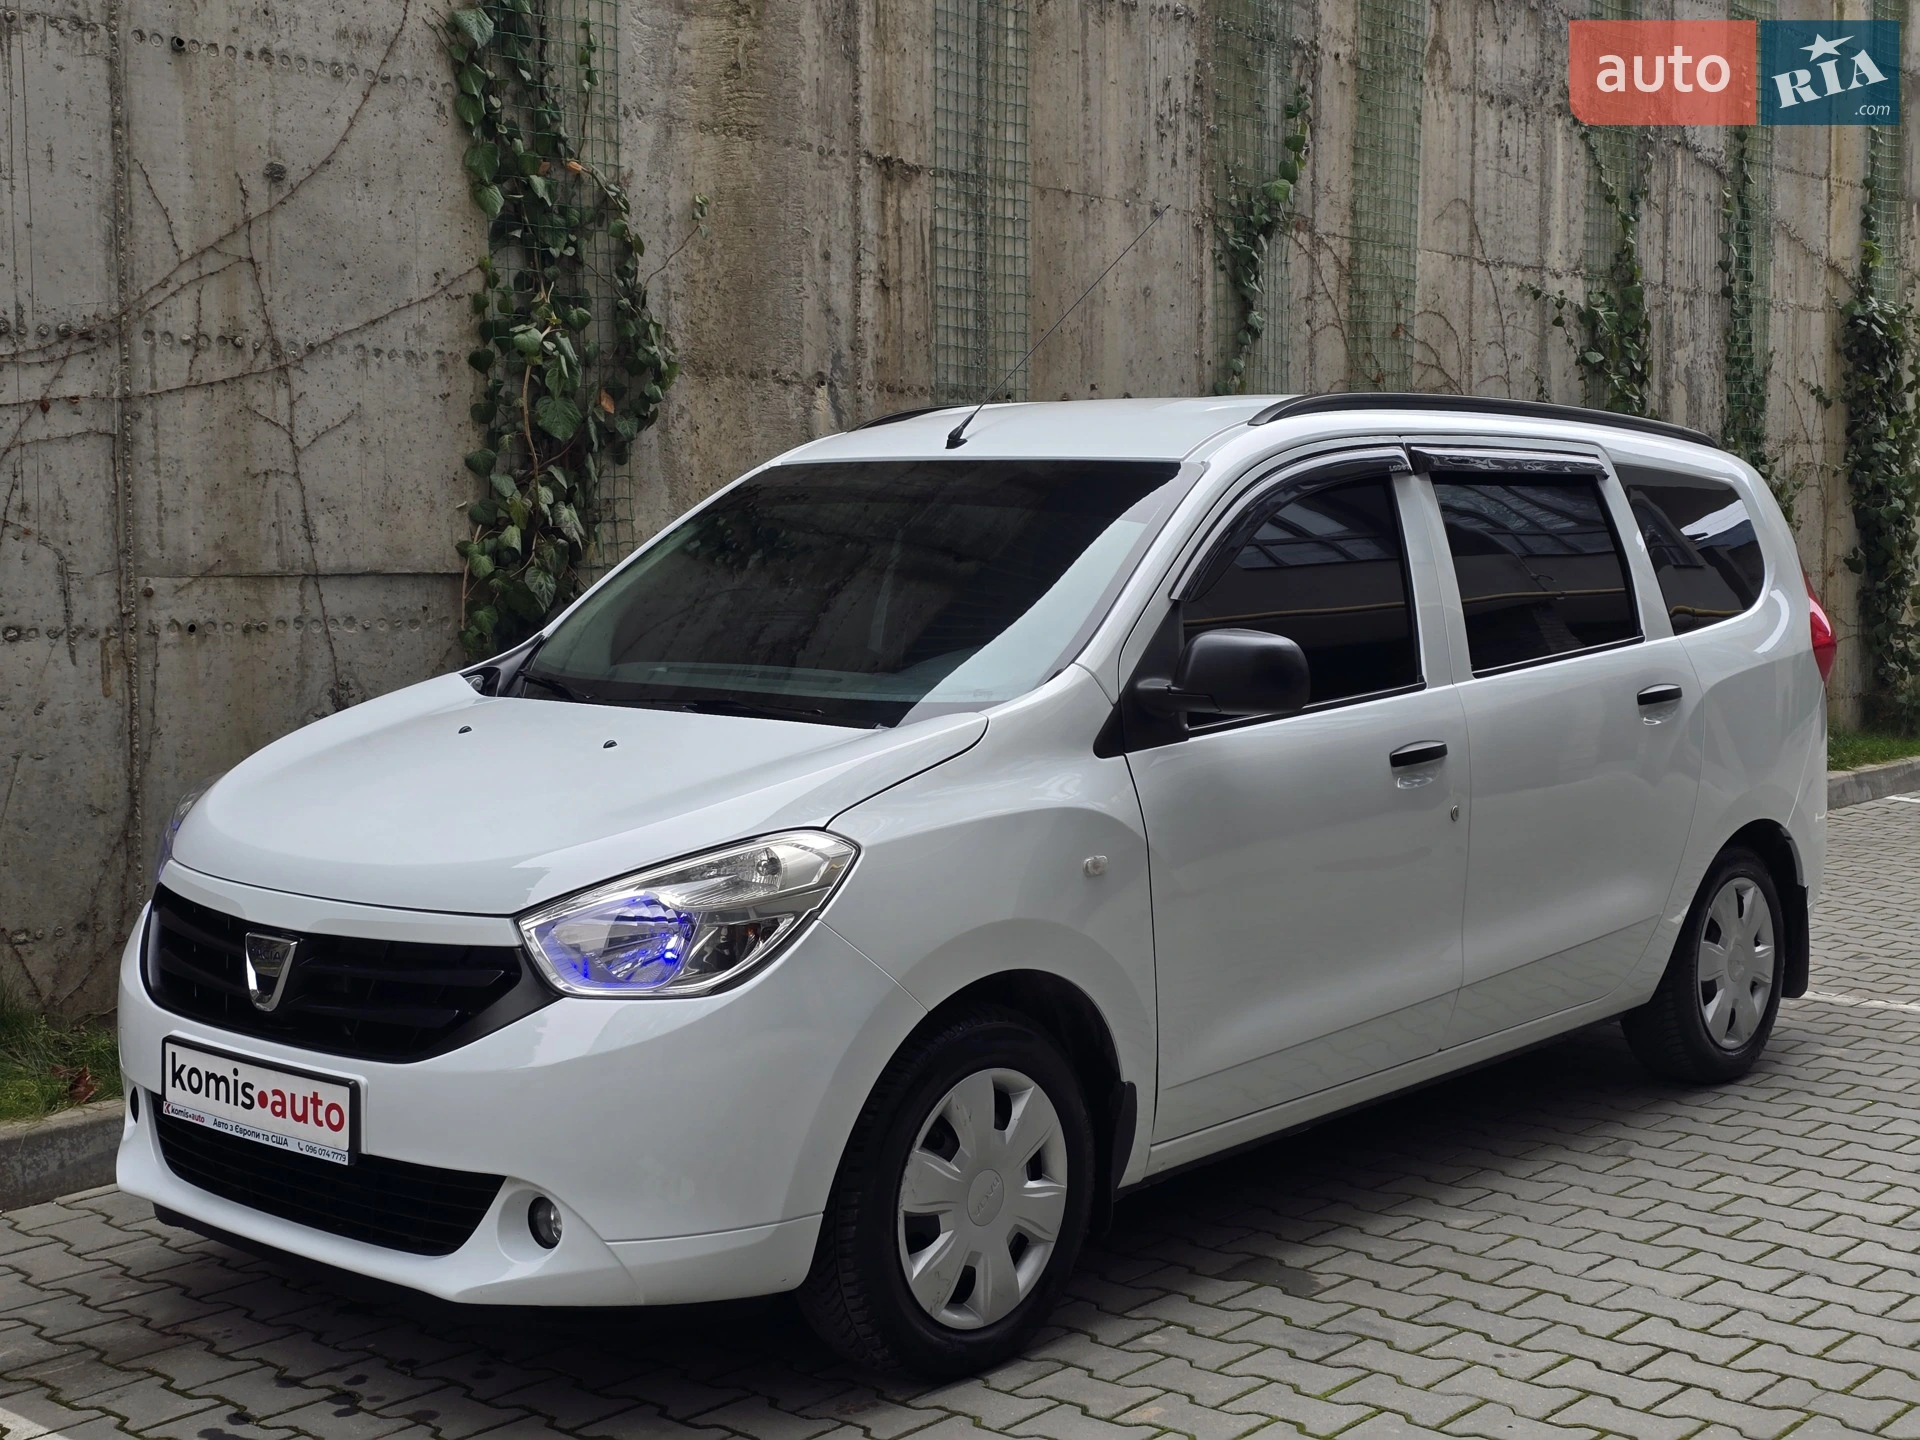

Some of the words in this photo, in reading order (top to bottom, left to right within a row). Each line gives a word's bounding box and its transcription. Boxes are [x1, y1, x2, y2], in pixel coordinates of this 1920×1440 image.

[212, 1118, 229, 1130] Авто
[234, 1125, 260, 1140] Європи
[261, 1133, 270, 1142] та
[270, 1134, 289, 1147] США
[305, 1144, 317, 1155] 096
[318, 1149, 330, 1159] 074
